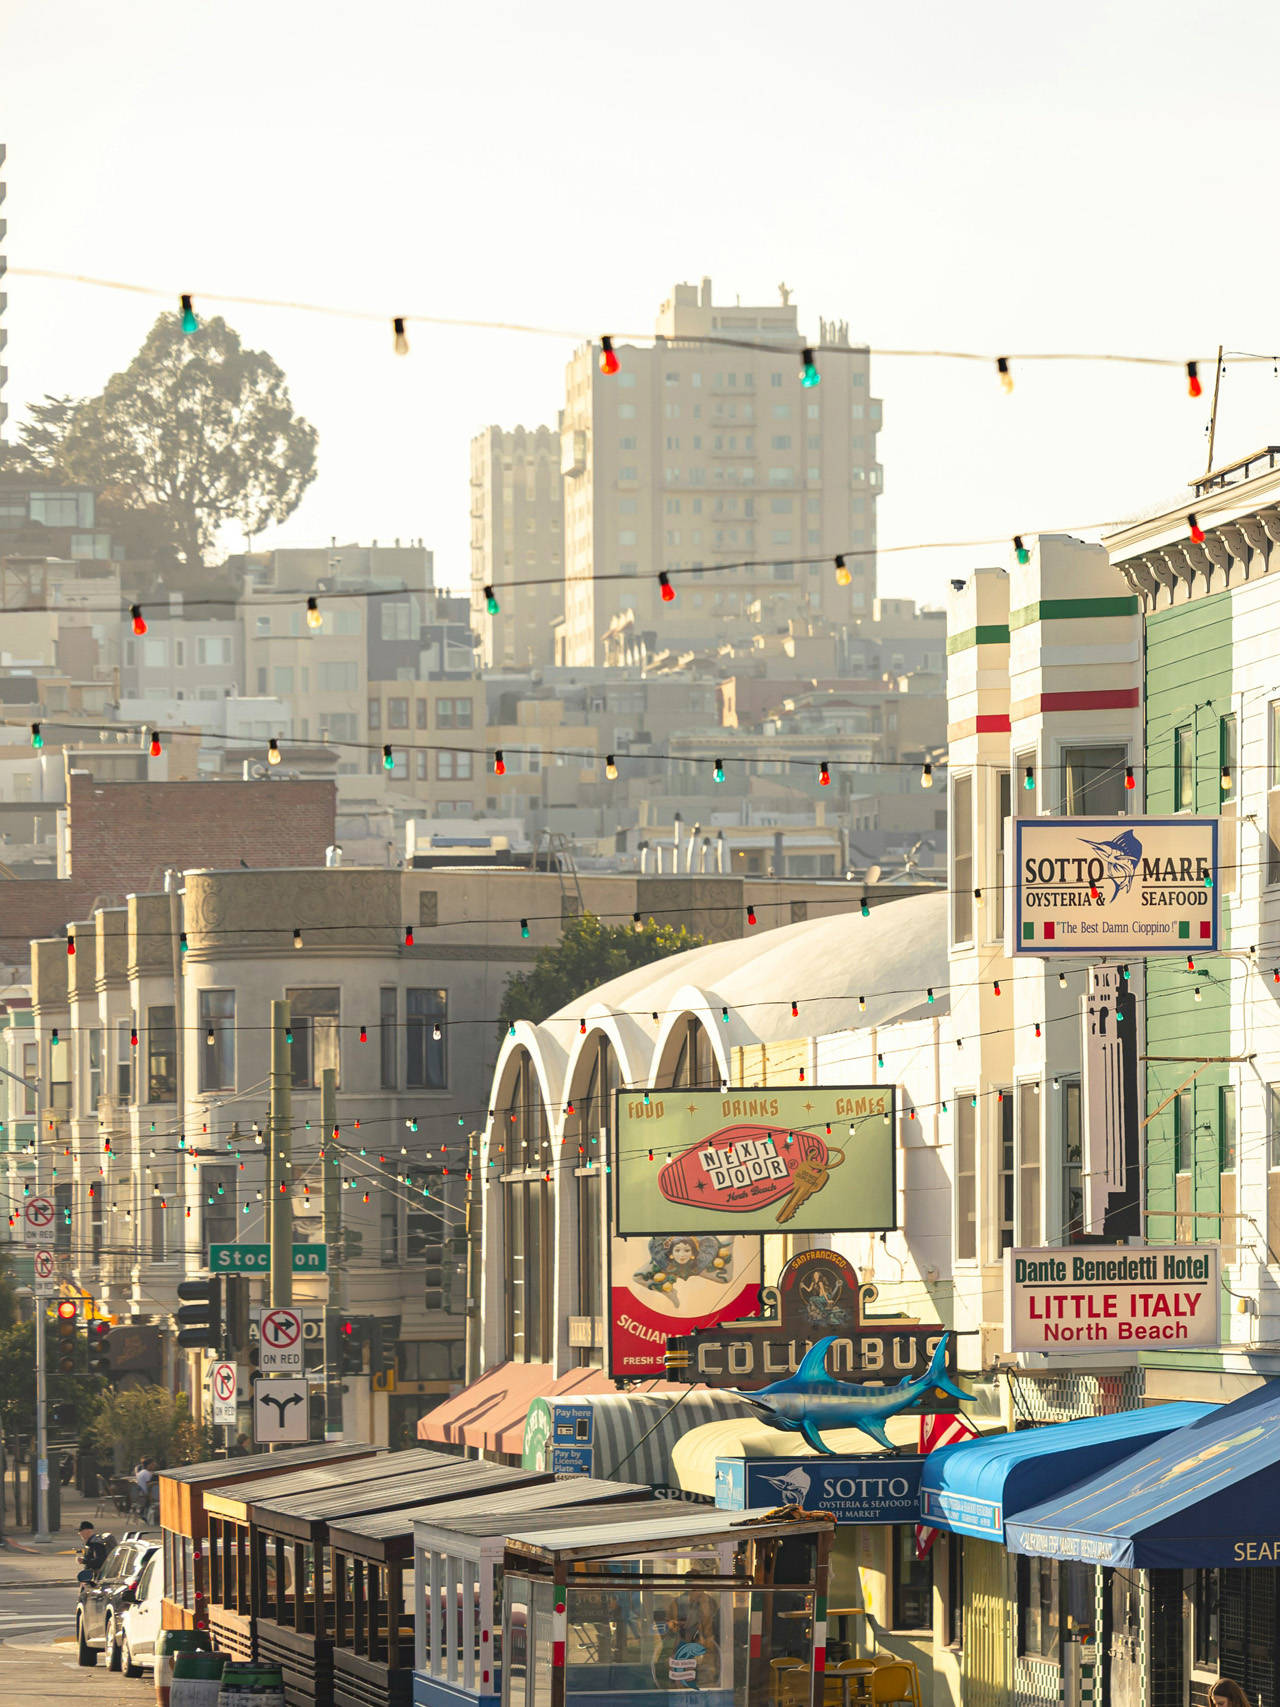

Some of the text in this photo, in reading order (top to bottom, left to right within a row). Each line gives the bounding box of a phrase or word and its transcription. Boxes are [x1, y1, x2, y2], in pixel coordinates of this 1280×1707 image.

[1025, 857, 1208, 883] SOTTO MARE
[1026, 891, 1208, 907] OYSTERIA & SEAFOOD
[1081, 921, 1098, 934] Best
[1102, 921, 1129, 933] Damn
[628, 1096, 885, 1119] FOOD DRINKS GAMES
[703, 1142, 773, 1167] NEXT
[716, 1160, 783, 1186] DOOR
[726, 1183, 777, 1202] North Beach
[26, 1231, 54, 1239] ON RED
[218, 1250, 319, 1266] Stocon
[791, 1250, 847, 1269] SAN FRANCISCO
[1015, 1255, 1209, 1283] Dante Benedetti Hotel
[1029, 1293, 1202, 1319] LITTLE ITALY
[1044, 1321, 1188, 1341] North Beach
[263, 1354, 300, 1364] ON RED
[623, 1356, 654, 1365] FRESH
[697, 1336, 951, 1375] COLUMBUS
[225, 1407, 235, 1416] RED
[556, 1408, 591, 1418] Pay here
[555, 1450, 581, 1459] Pay by
[555, 1457, 583, 1465] License
[823, 1477, 909, 1498] SOTTO
[819, 1500, 861, 1509] OYSTERIA
[870, 1500, 911, 1508] SEAFOOD
[845, 1510, 880, 1518] MARKET
